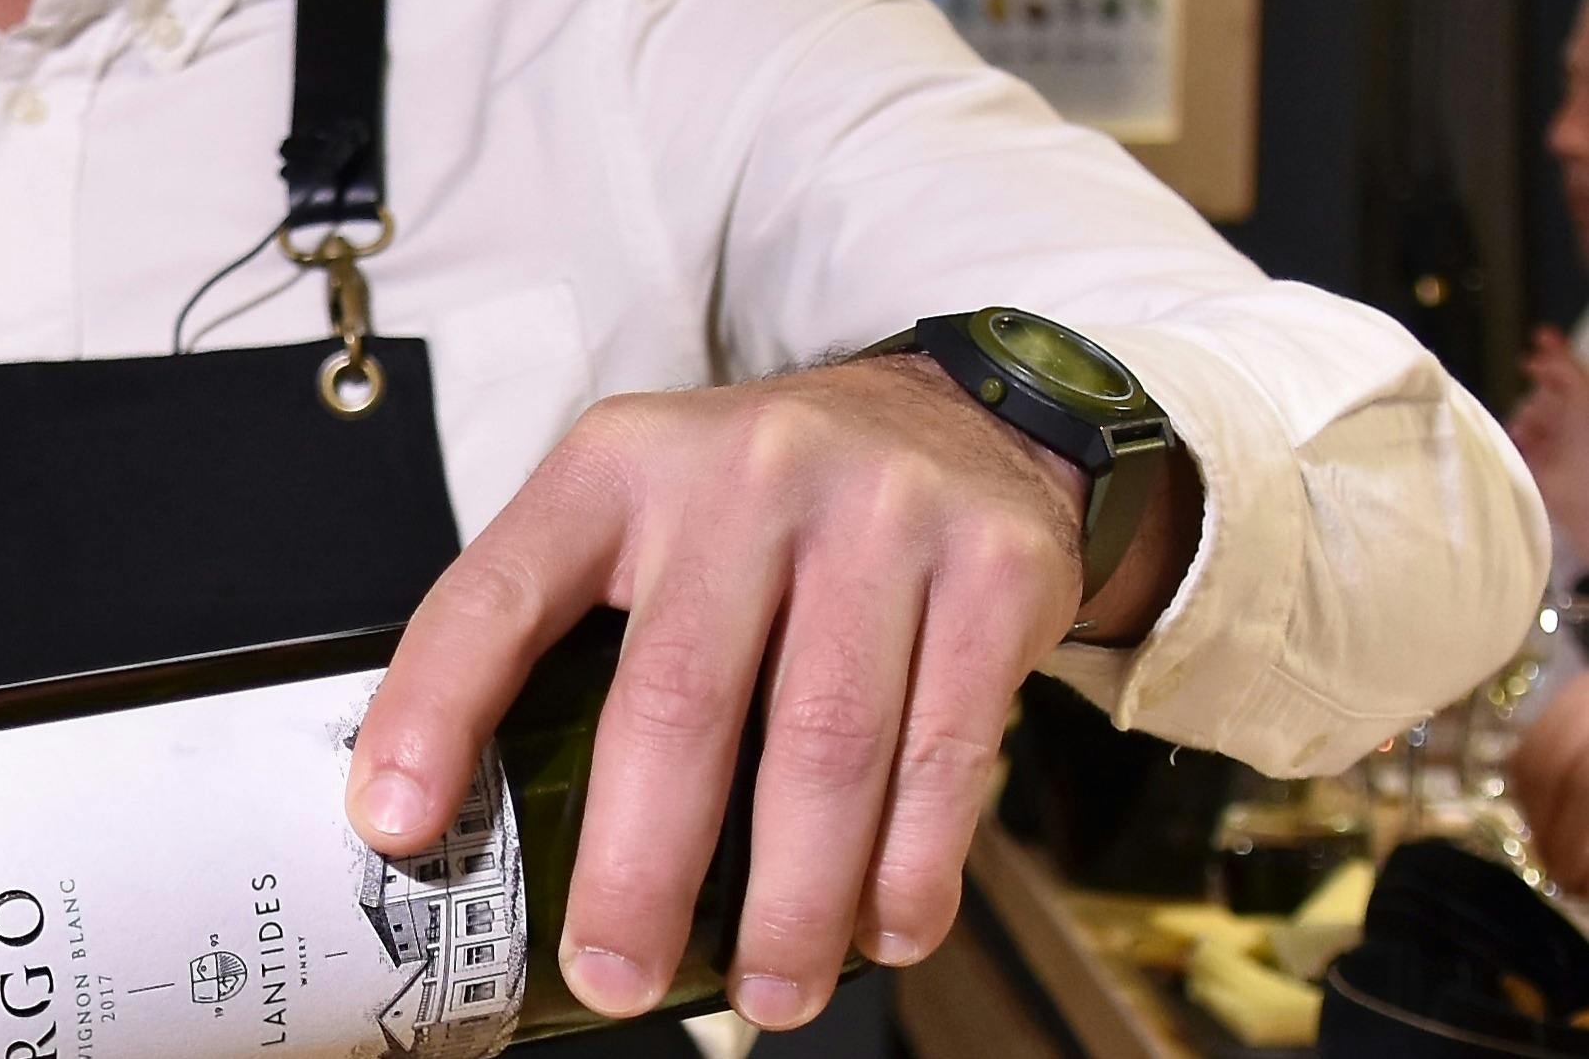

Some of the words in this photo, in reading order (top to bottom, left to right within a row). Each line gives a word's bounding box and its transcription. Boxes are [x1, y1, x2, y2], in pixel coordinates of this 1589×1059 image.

[60, 879, 86, 959] BLANC
[210, 934, 219, 947] 93
[251, 874, 287, 1047] LANTIDES
[298, 936, 308, 987] WINERY
[99, 975, 115, 1022] 2017
[214, 1006, 224, 1018] 19
